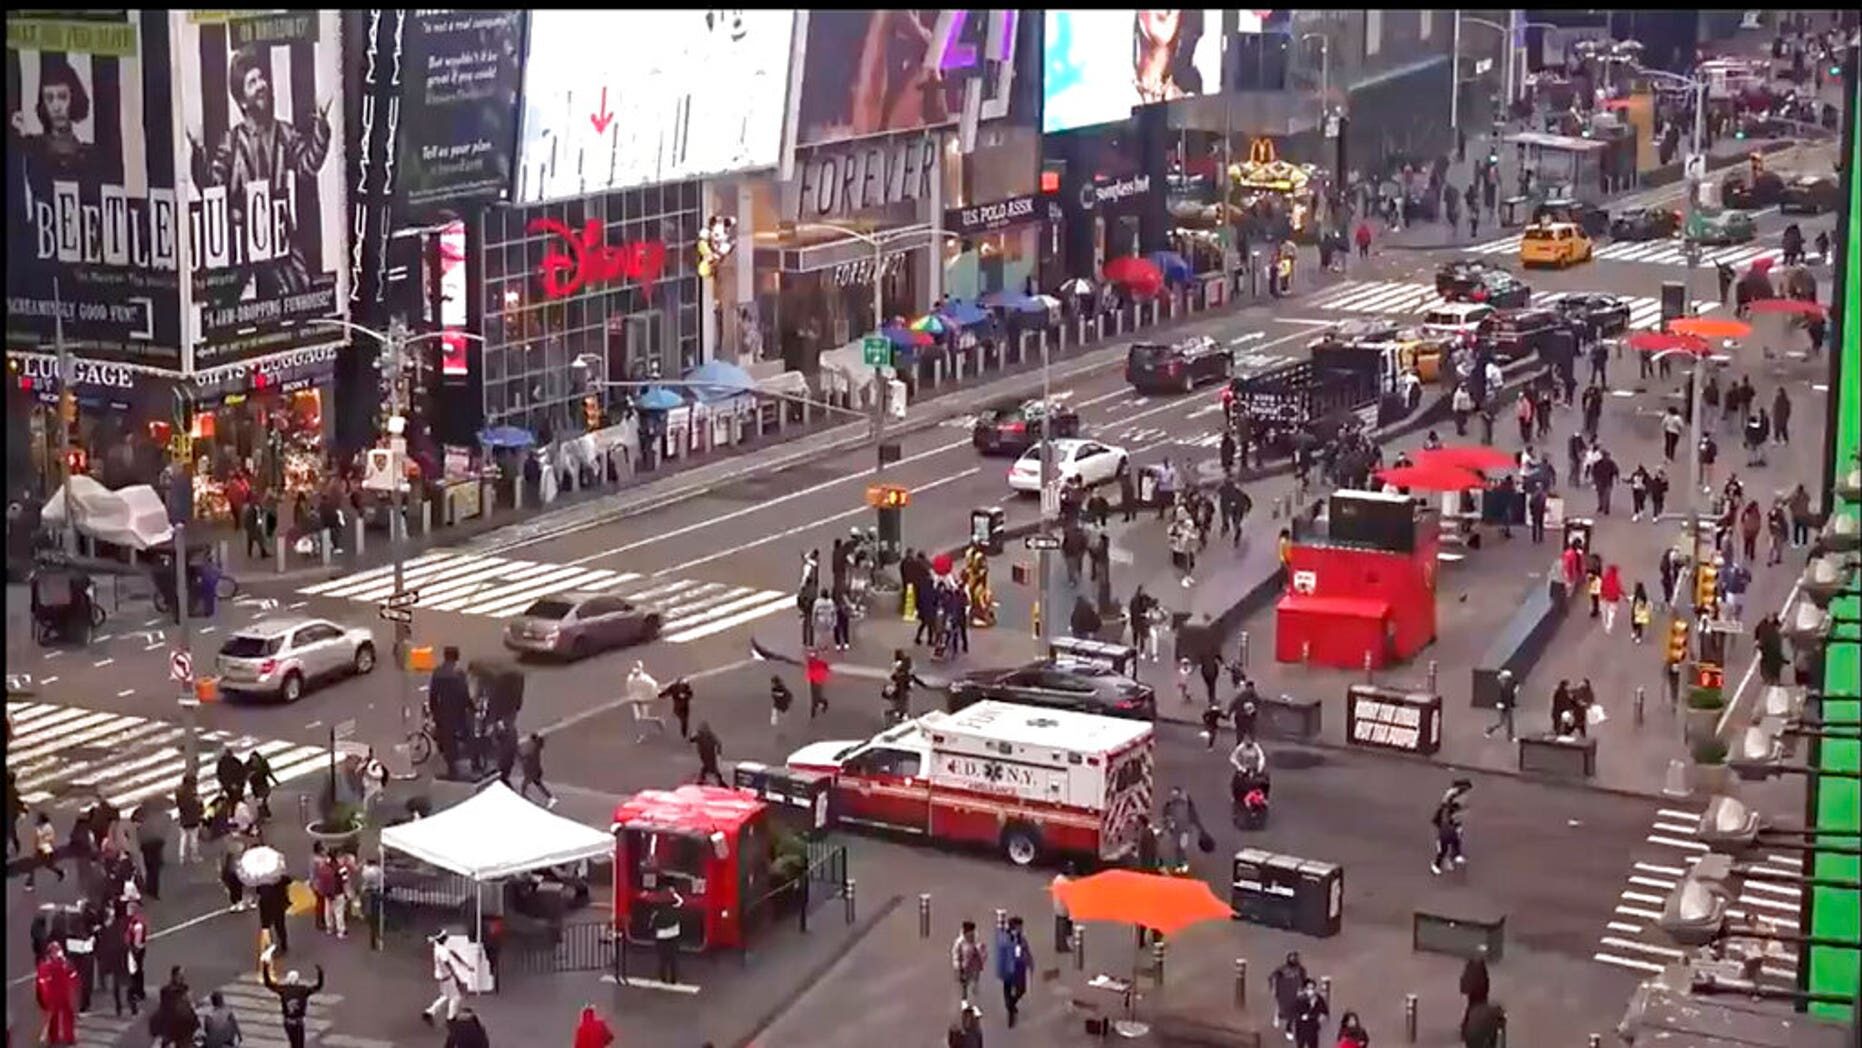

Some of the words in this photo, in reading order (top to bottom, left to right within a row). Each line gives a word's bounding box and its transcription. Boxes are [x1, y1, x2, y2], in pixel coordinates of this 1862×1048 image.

[797, 140, 935, 222] FOREVER
[980, 203, 1006, 223] POLO
[36, 184, 177, 269] BEETLE
